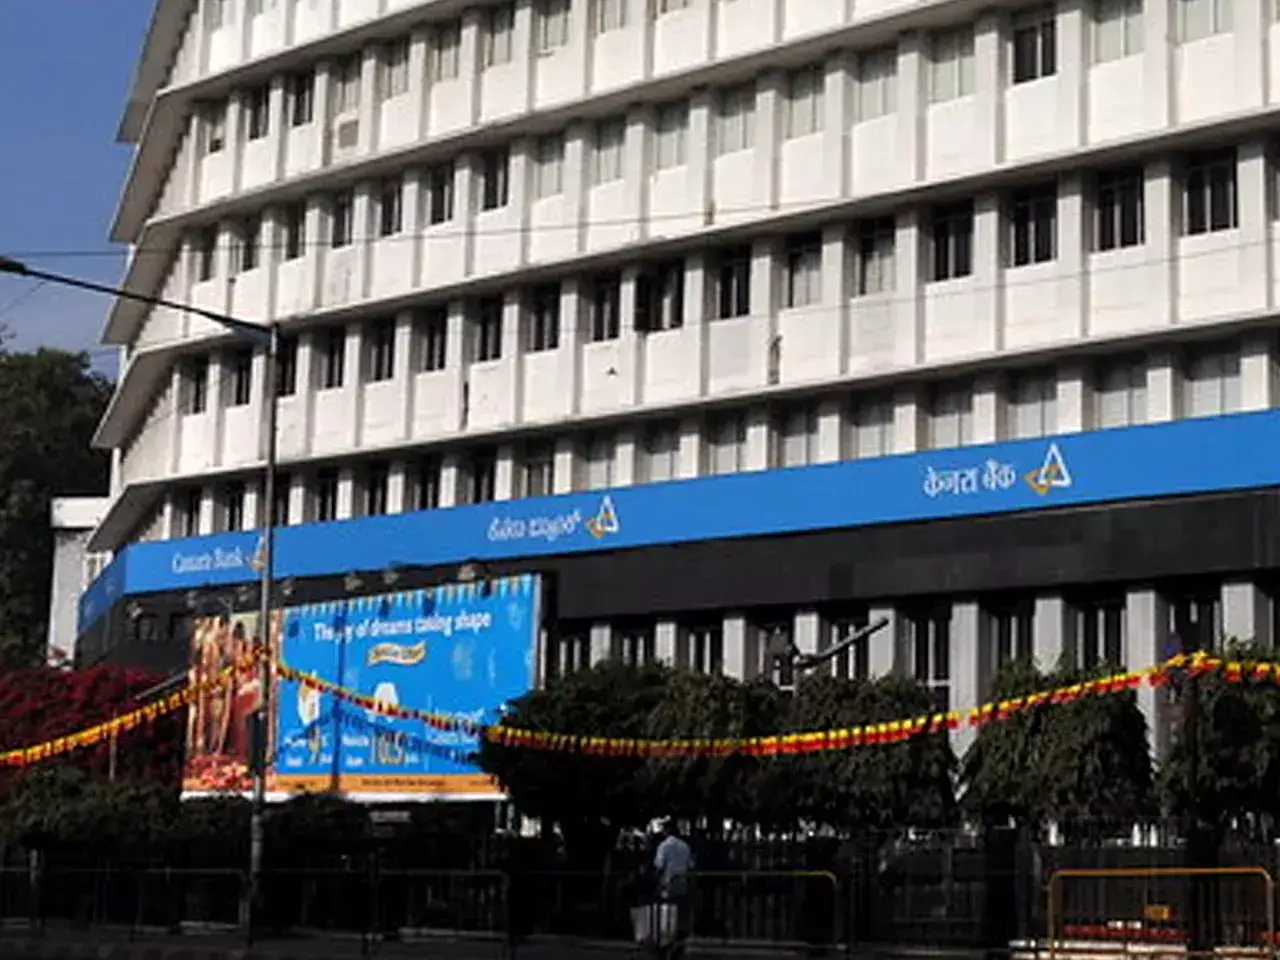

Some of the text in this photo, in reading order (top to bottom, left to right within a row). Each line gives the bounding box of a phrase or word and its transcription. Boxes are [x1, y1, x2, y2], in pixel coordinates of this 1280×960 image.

[355, 618, 370, 638] of
[371, 618, 412, 637] dreams
[455, 608, 492, 635] shape
